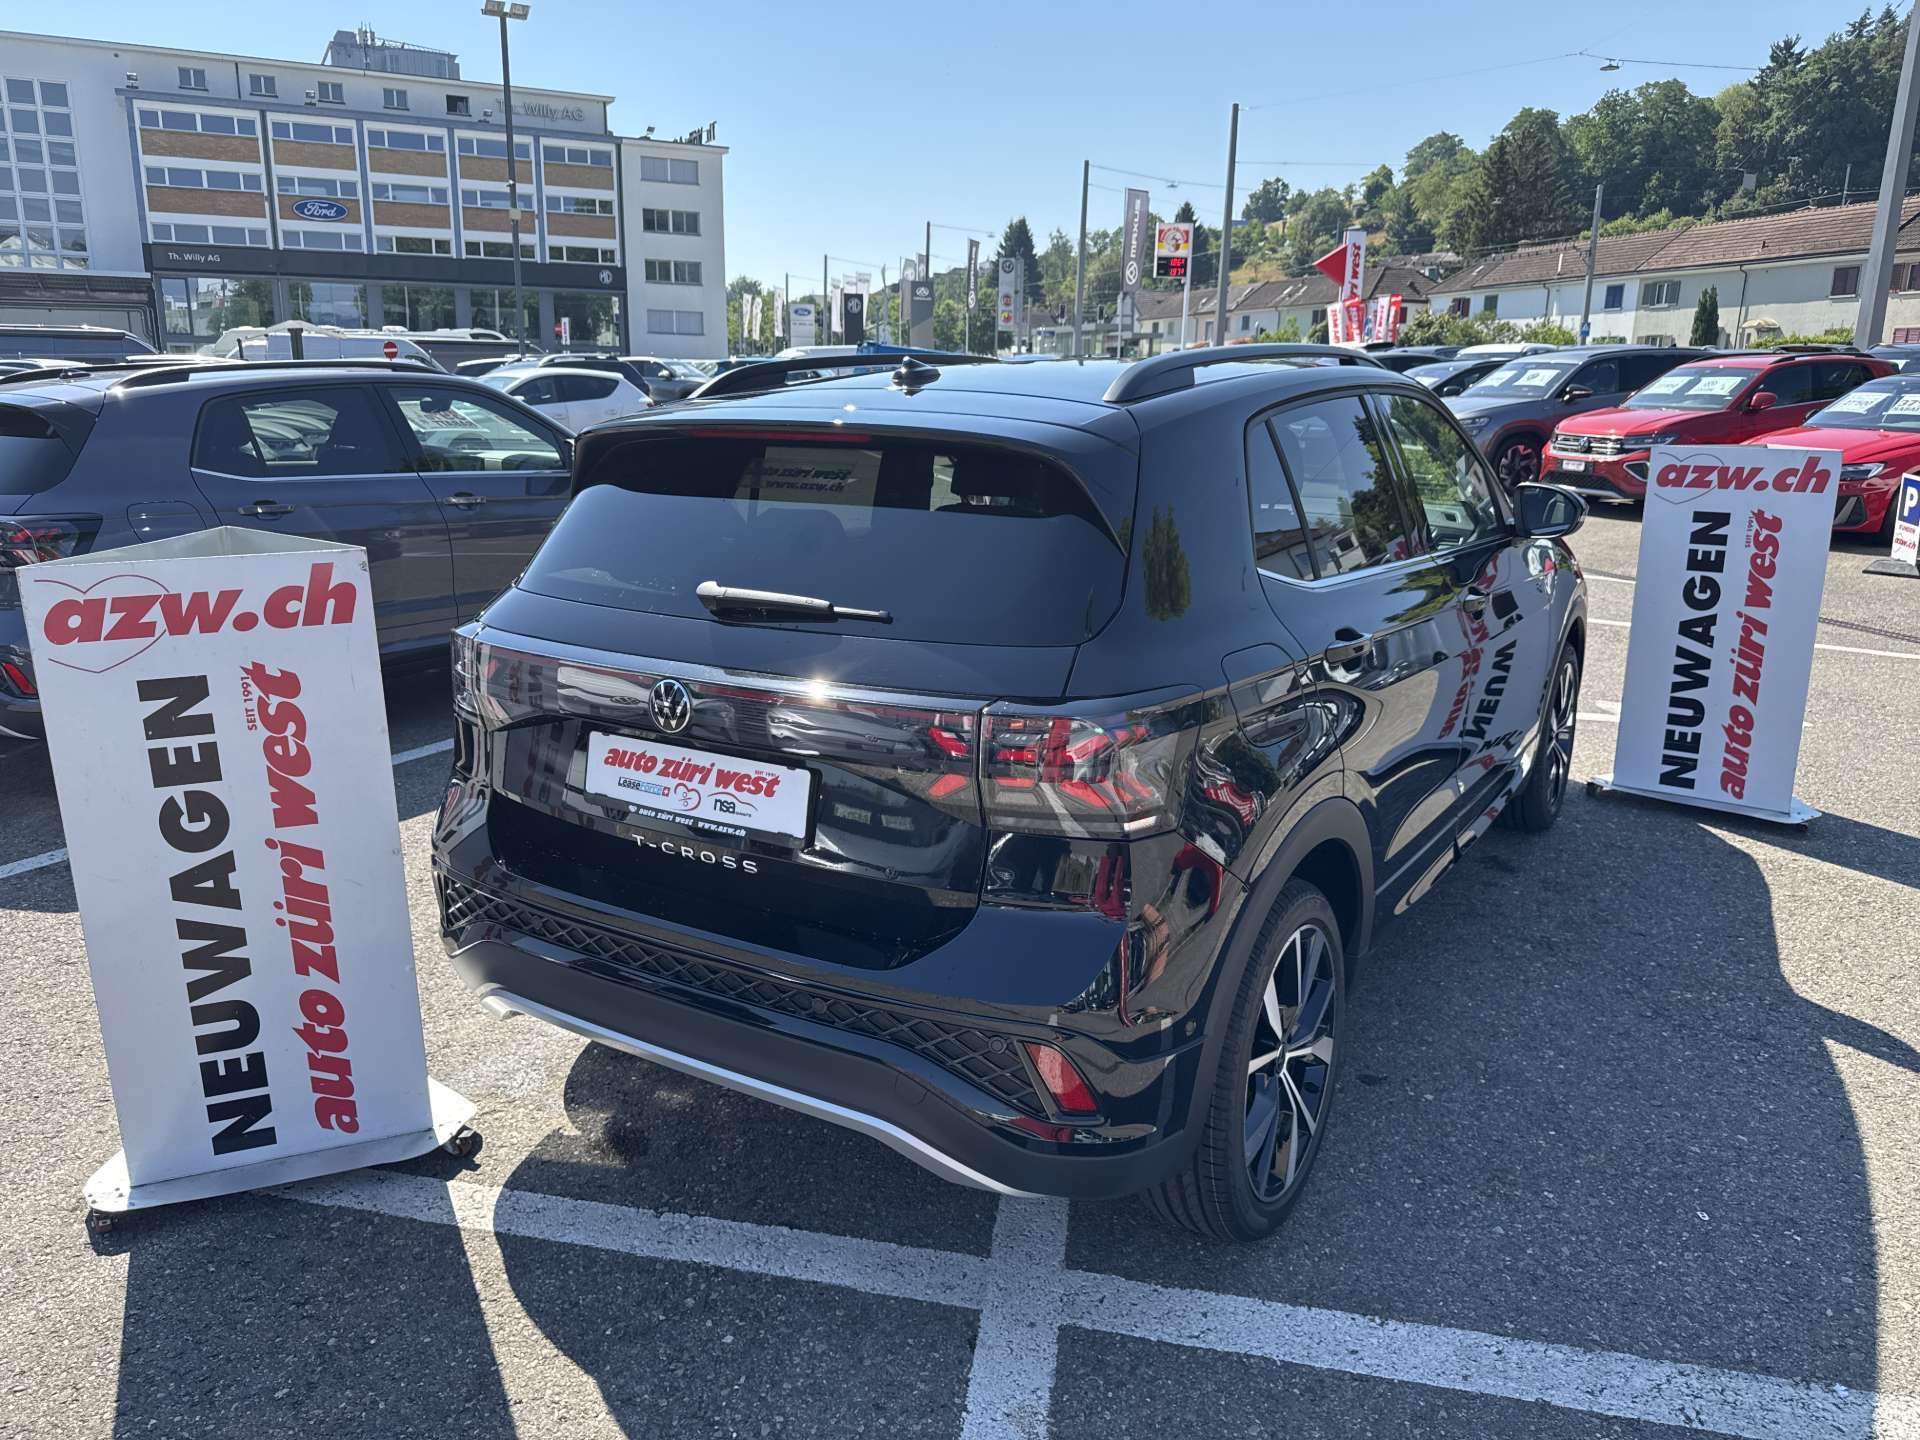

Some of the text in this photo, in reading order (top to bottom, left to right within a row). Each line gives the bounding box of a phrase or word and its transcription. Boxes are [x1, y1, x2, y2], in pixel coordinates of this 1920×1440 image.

[523, 102, 559, 122] Willy
[562, 105, 585, 122] AG
[303, 202, 338, 218] Ford
[168, 252, 221, 264] Th. Willy AG
[1656, 456, 1831, 494] azw.ch
[1903, 486, 1919, 517] P
[43, 562, 357, 645] azw.ch
[1659, 510, 1731, 790] NEUWAGEN
[1720, 508, 1783, 800] auto züri west
[241, 675, 258, 731] SEIT 1991
[604, 747, 781, 799] auto züri west
[638, 807, 656, 818] auto
[656, 812, 674, 822] züri
[675, 816, 694, 827] west
[713, 798, 736, 815] nsa
[631, 833, 759, 875] T-CROSS
[136, 674, 278, 1156] NEUWAGEN
[239, 660, 359, 1134] auto züri west
